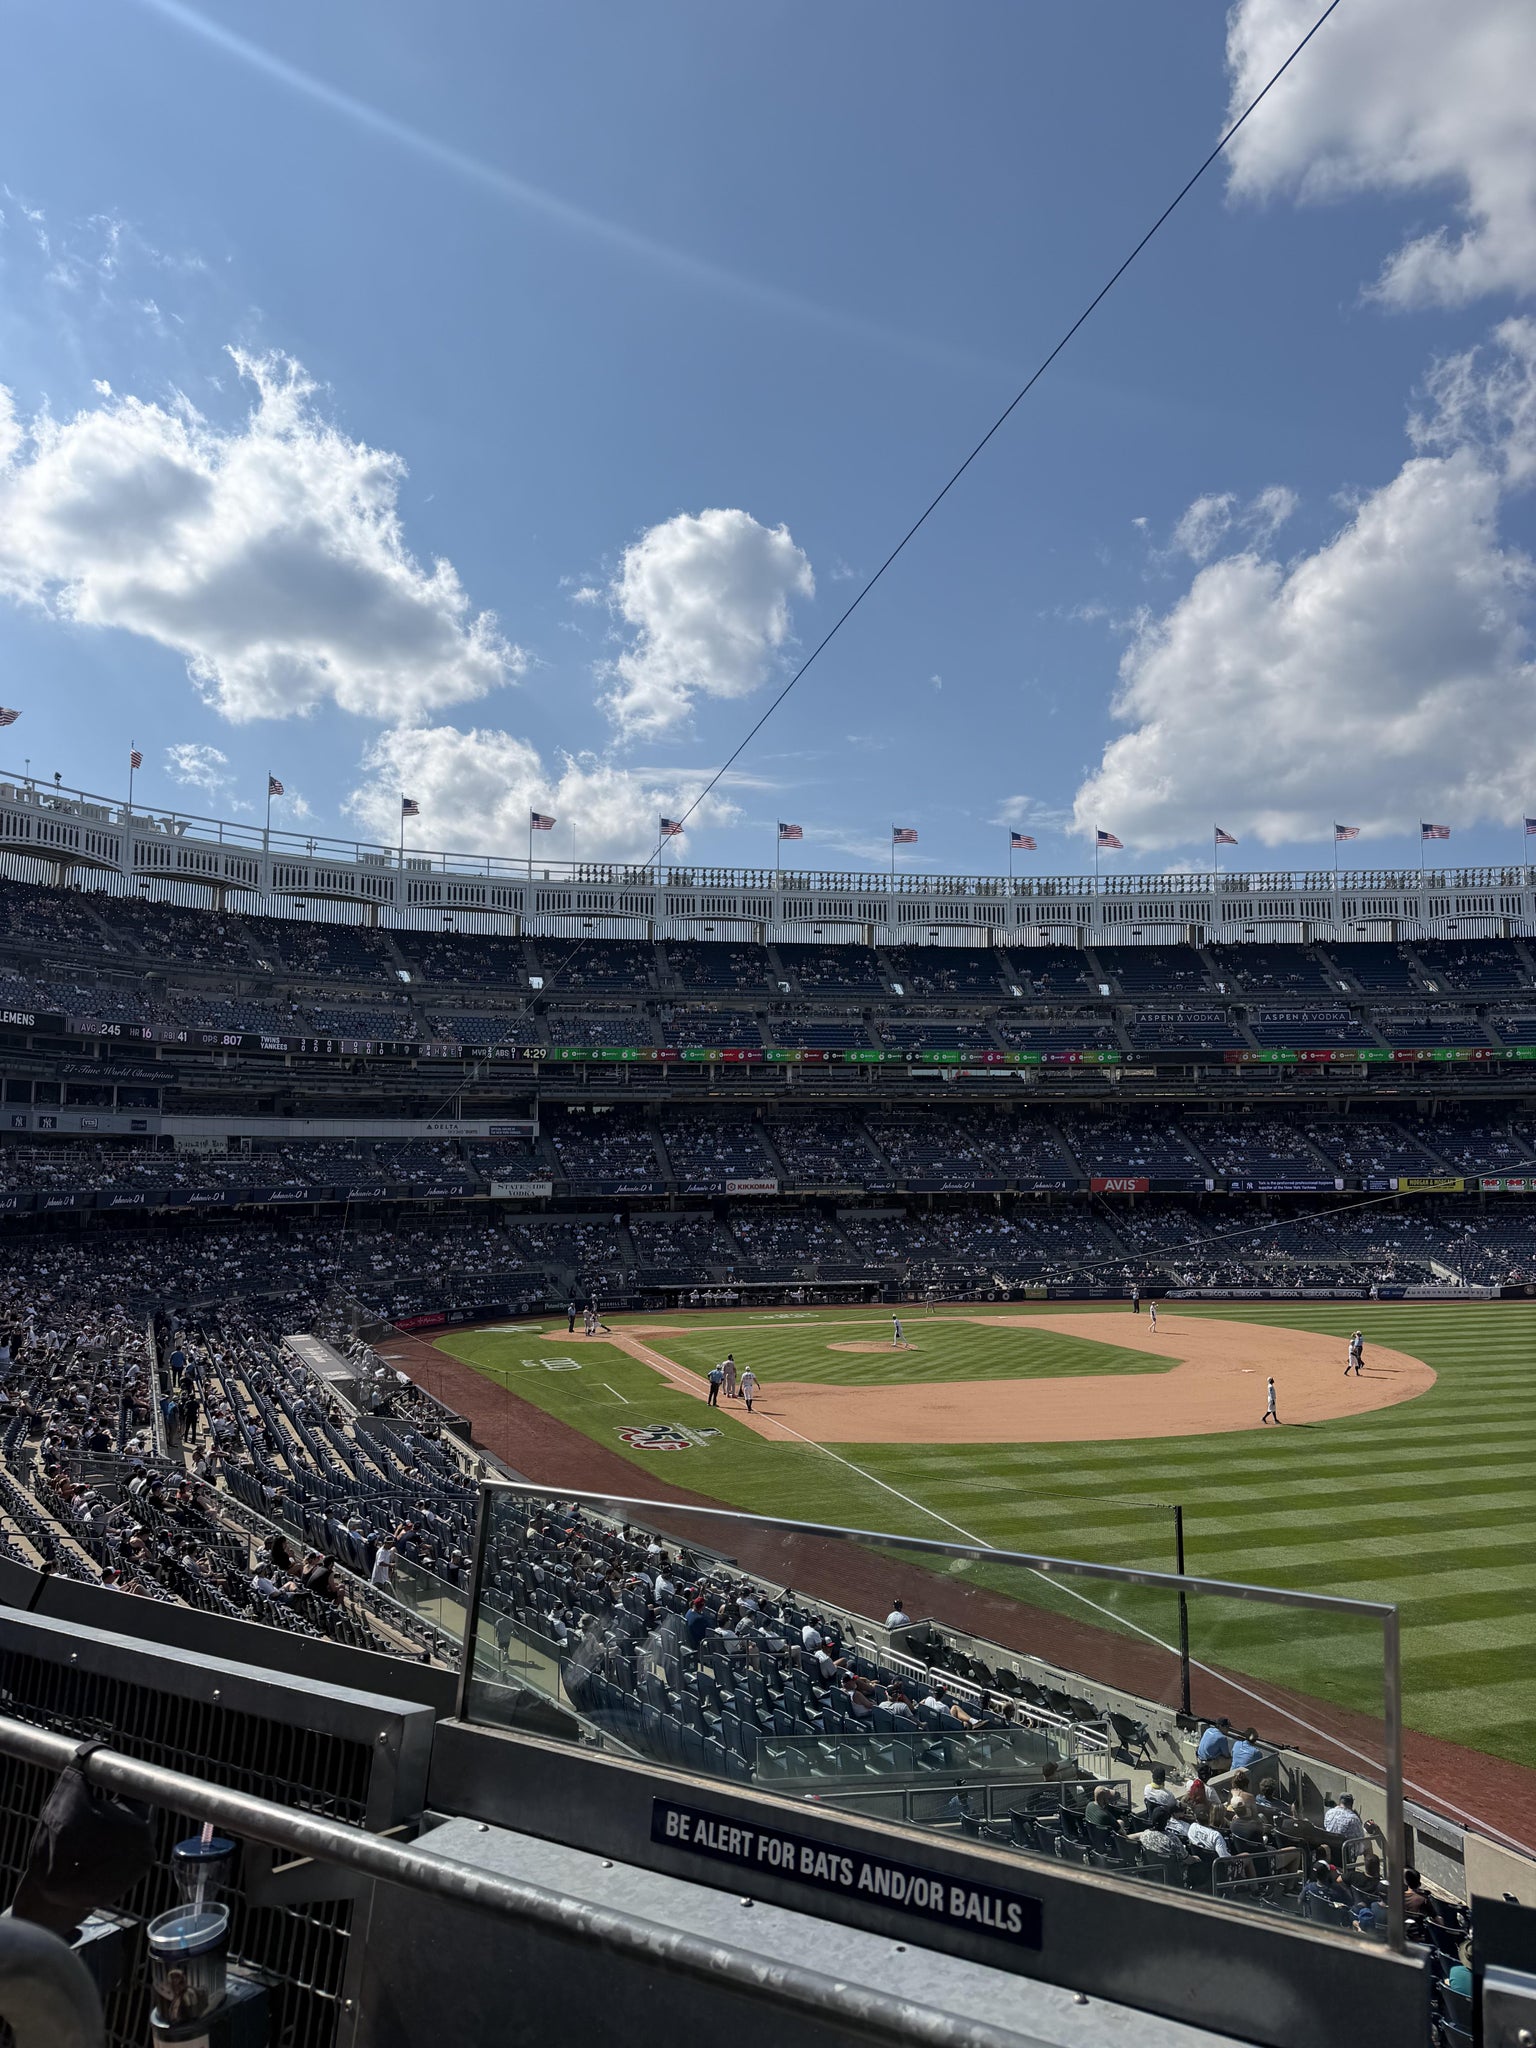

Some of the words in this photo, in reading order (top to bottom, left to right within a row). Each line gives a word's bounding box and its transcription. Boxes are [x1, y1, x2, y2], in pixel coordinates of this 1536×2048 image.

[80, 1023, 96, 1033] AVG
[98, 1024, 121, 1036] .245
[129, 1027, 139, 1037] HR
[142, 1027, 152, 1039] 16
[163, 1030, 175, 1040] RBI
[177, 1031, 187, 1042] 41
[202, 1034, 218, 1043] OPS
[220, 1035, 243, 1046] .807
[260, 1042, 288, 1050] YANKEES
[496, 1049, 509, 1057] ABS
[523, 1049, 547, 1059] 4:29
[62, 1064, 100, 1075] 27-Time
[104, 1066, 129, 1077] World
[132, 1068, 176, 1081] Champions
[1104, 1180, 1136, 1190] AVIS
[665, 1811, 692, 1841] BE
[693, 1818, 755, 1858] ALERT
[757, 1835, 795, 1871] FOR
[799, 1846, 854, 1886] BATS
[858, 1863, 944, 1912] AND/OR
[948, 1887, 1022, 1934] BALLS
